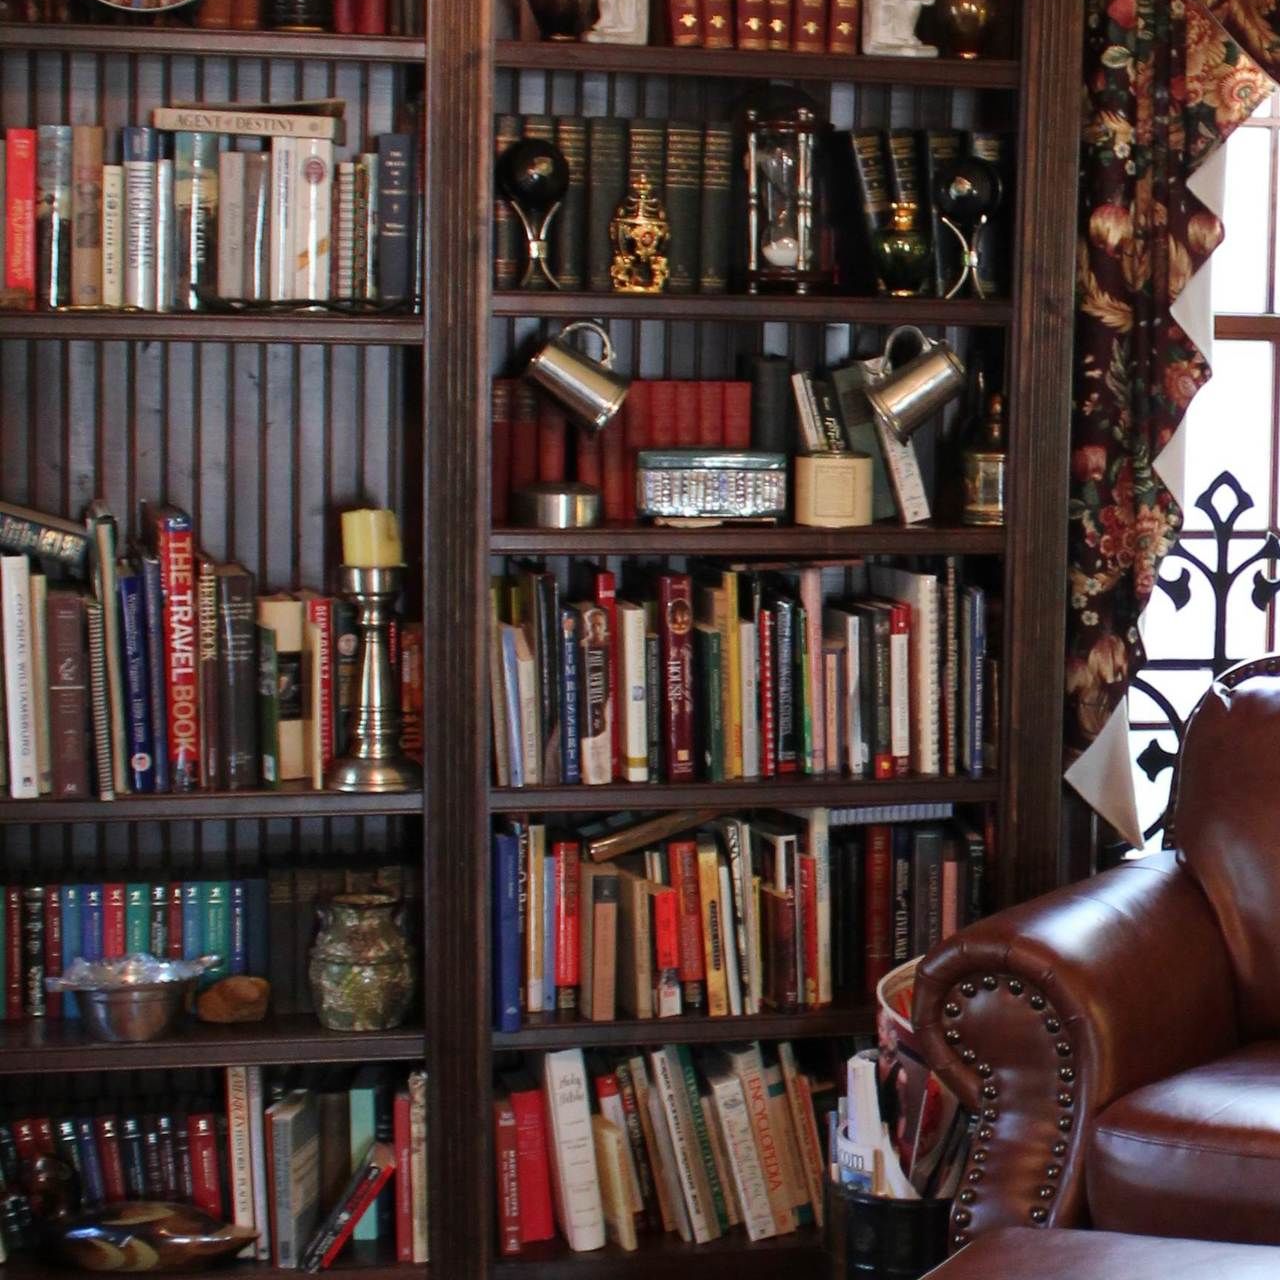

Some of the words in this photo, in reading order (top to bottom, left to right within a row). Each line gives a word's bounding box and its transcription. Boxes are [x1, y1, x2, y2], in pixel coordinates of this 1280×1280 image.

[176, 114, 221, 128] AGENT
[236, 117, 295, 132] DESTINY
[128, 167, 153, 194] THE
[128, 197, 153, 269] GENERALS
[169, 537, 192, 586] THE
[199, 575, 216, 617] HERB
[15, 593, 26, 657] COLONIAL
[170, 590, 193, 683] TRAVEL
[315, 605, 328, 629] DEAN
[201, 619, 217, 662] BOOK
[565, 642, 576, 676] TIM
[589, 650, 604, 668] PAUL
[589, 671, 605, 704] NEWMAN
[666, 660, 682, 700] HOUSE
[779, 677, 791, 702] GHOST
[18, 662, 32, 756] WILLIAMSBURG
[173, 685, 195, 753] BOOK
[566, 681, 577, 760] RUSSERT
[780, 704, 793, 736] STORIES
[895, 910, 908, 935] CIVIL
[895, 937, 908, 960] WAR
[659, 1057, 671, 1090] NORMAN
[230, 1070, 247, 1127] AMERICAN
[748, 1077, 784, 1191] ENCYCLOPEDIA
